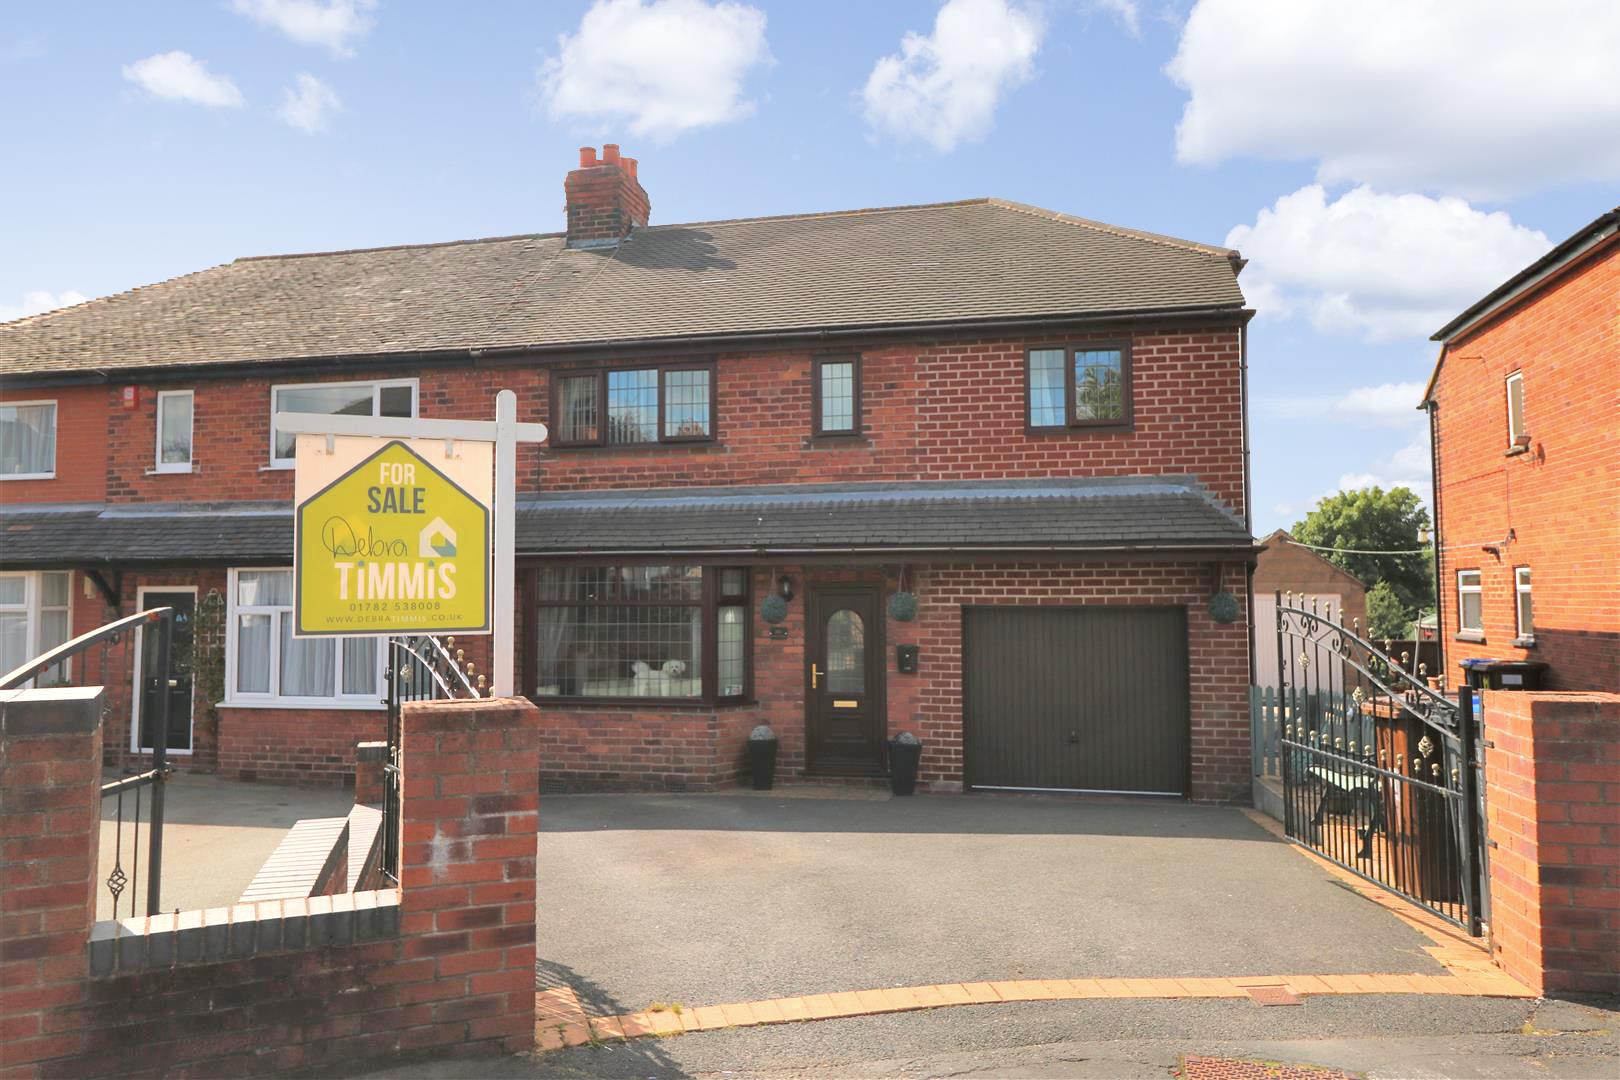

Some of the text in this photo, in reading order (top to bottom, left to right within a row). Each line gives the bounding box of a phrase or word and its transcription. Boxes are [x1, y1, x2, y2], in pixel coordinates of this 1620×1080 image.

[379, 462, 416, 485] FOR
[367, 486, 426, 514] SALE
[321, 515, 408, 559] Debra
[349, 601, 441, 612] 01782 538008
